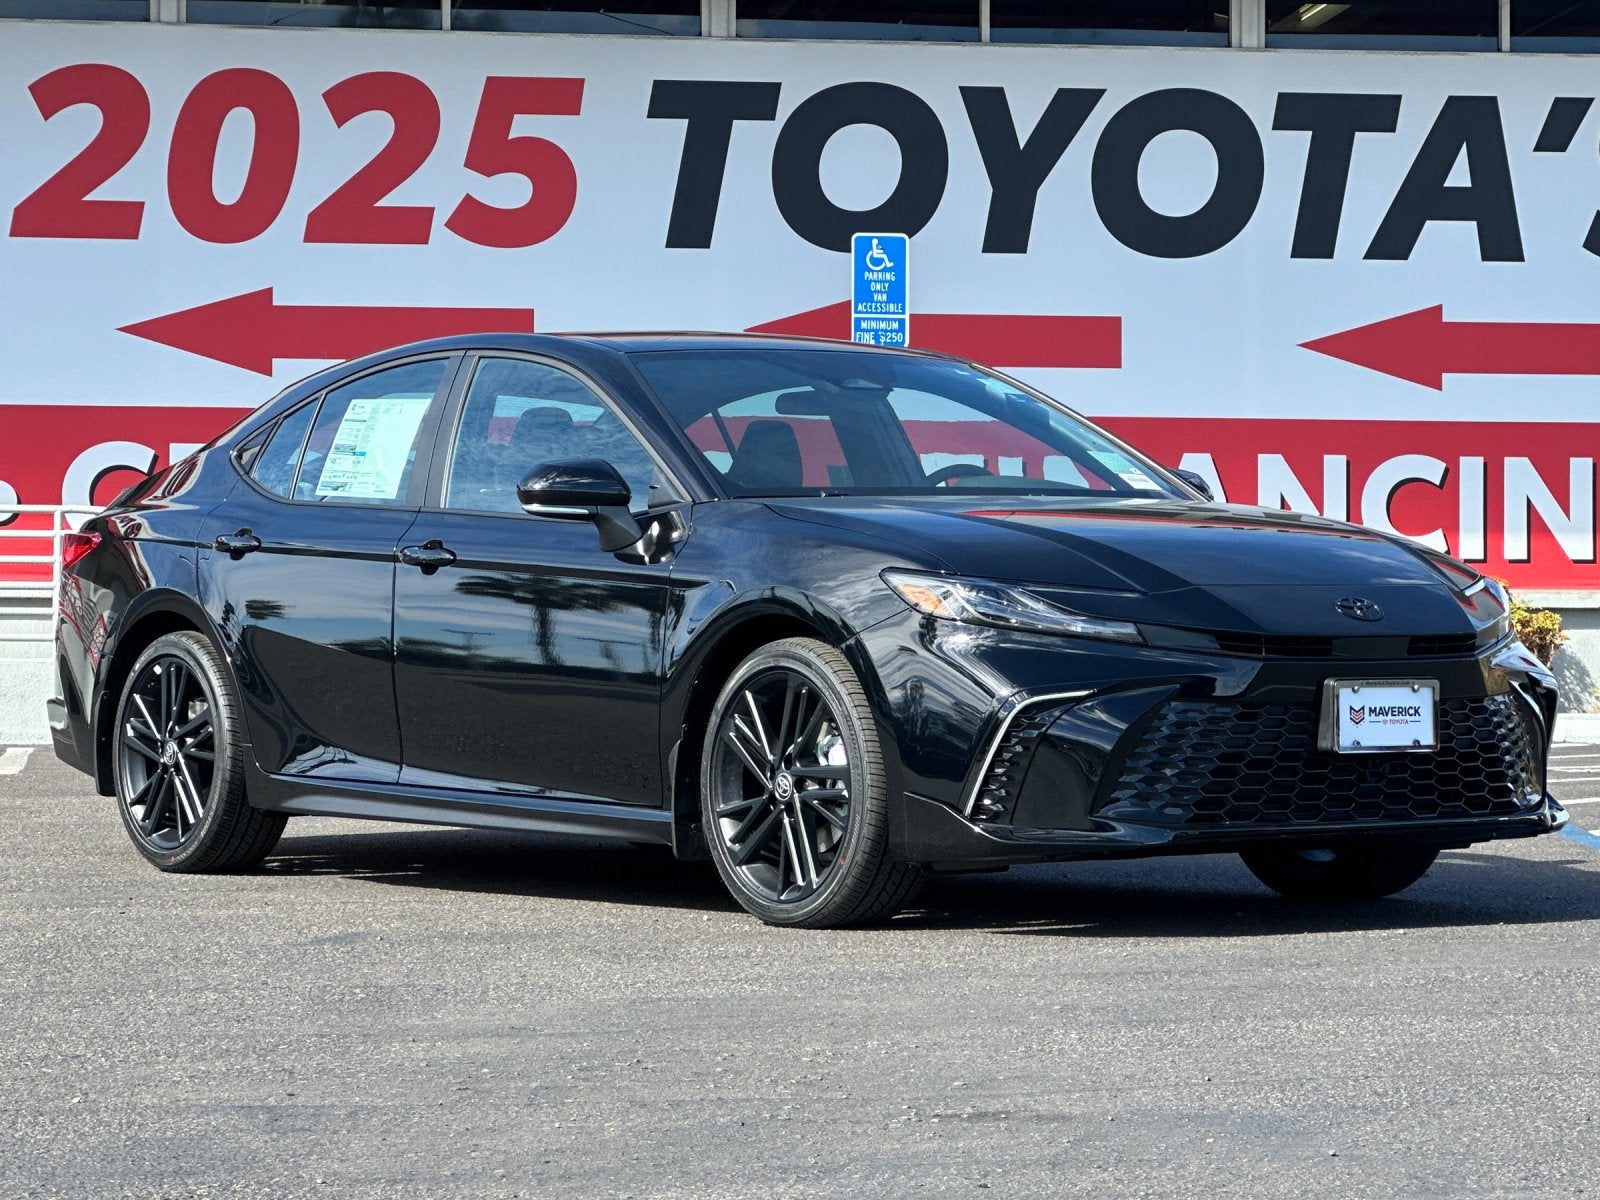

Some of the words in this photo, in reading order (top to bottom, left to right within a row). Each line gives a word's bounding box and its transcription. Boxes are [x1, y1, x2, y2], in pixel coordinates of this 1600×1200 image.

[9, 63, 585, 248] 2025
[648, 80, 1600, 262] TOYOTA'
[864, 271, 896, 281] PARKING
[870, 282, 889, 291] ONLY
[873, 293, 888, 302] VAN
[857, 303, 903, 313] ACCESSIBLE
[861, 320, 899, 330] MINIMUM
[856, 331, 875, 343] FINE
[878, 331, 903, 344] $250
[1368, 706, 1421, 717] MAVERICK
